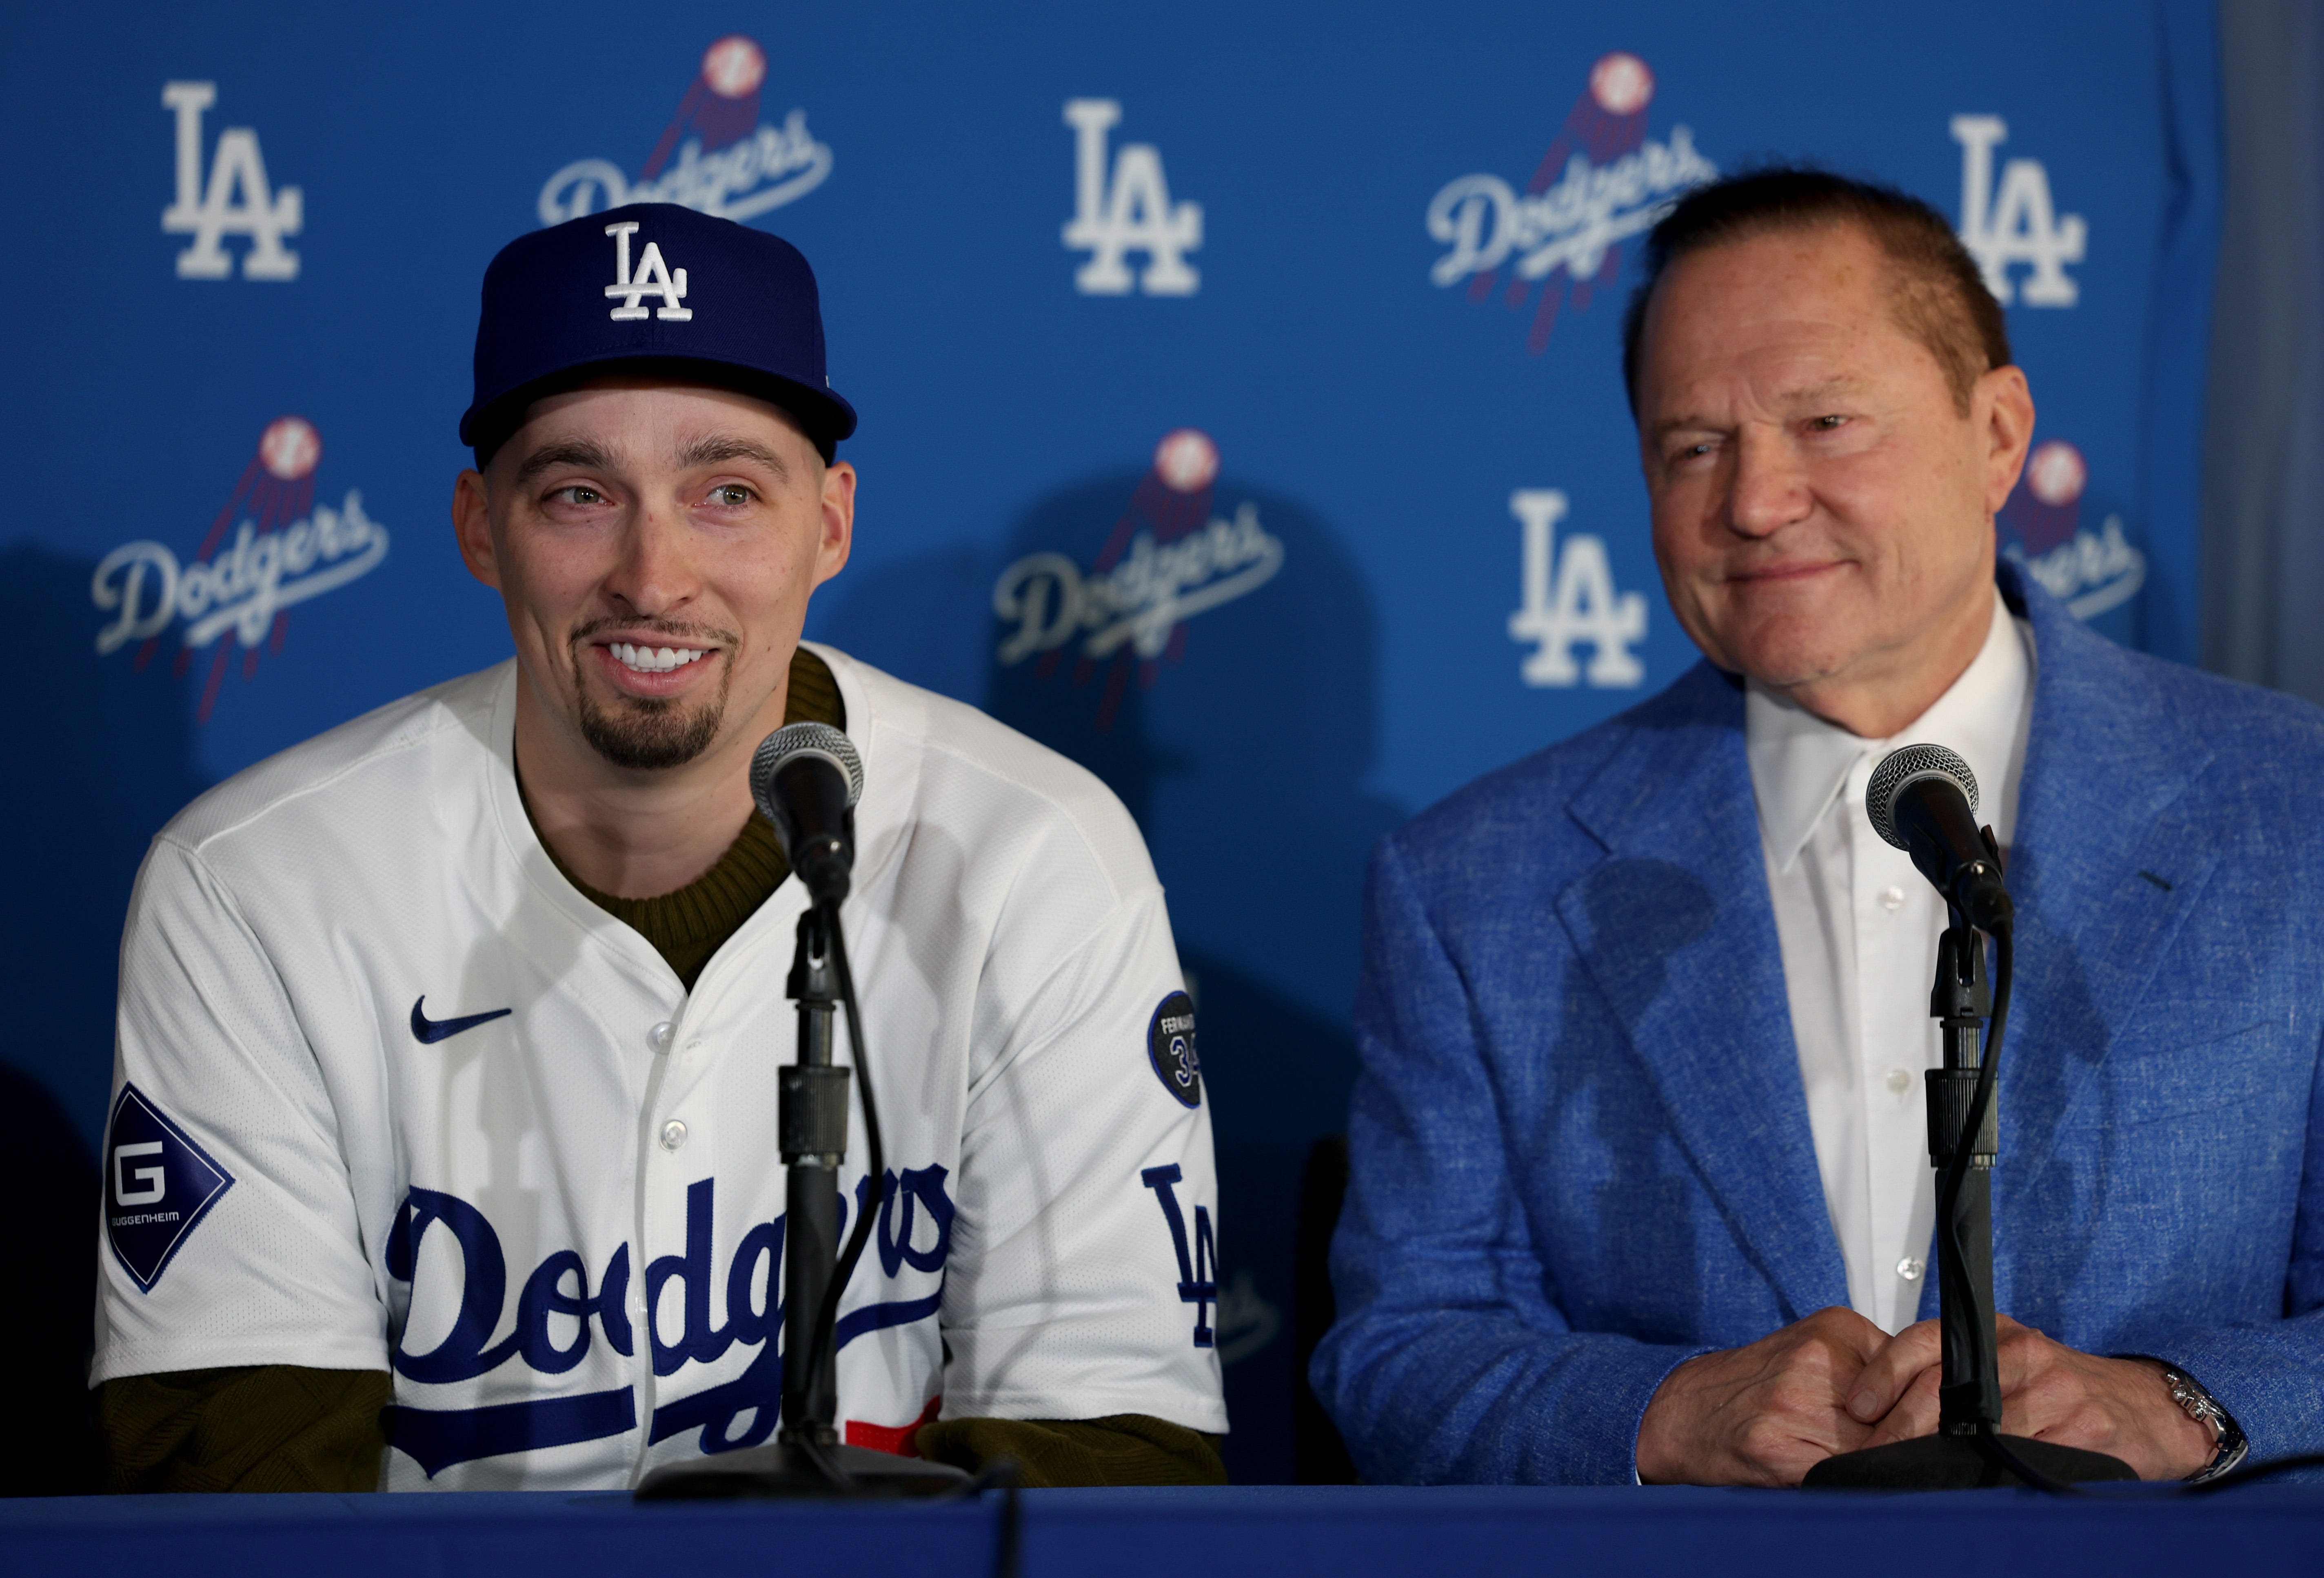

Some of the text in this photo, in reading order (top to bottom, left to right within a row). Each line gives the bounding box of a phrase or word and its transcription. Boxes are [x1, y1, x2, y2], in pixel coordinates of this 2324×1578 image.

[162, 80, 303, 280] LA
[604, 221, 693, 322] LA
[1061, 98, 1204, 296] LA
[1949, 114, 2087, 308] LA
[91, 489, 390, 655] Dodgers
[993, 501, 1285, 667] Dodgers
[1509, 489, 1648, 687] LA
[114, 1141, 165, 1207] G
[1141, 1162, 1218, 1348] LA
